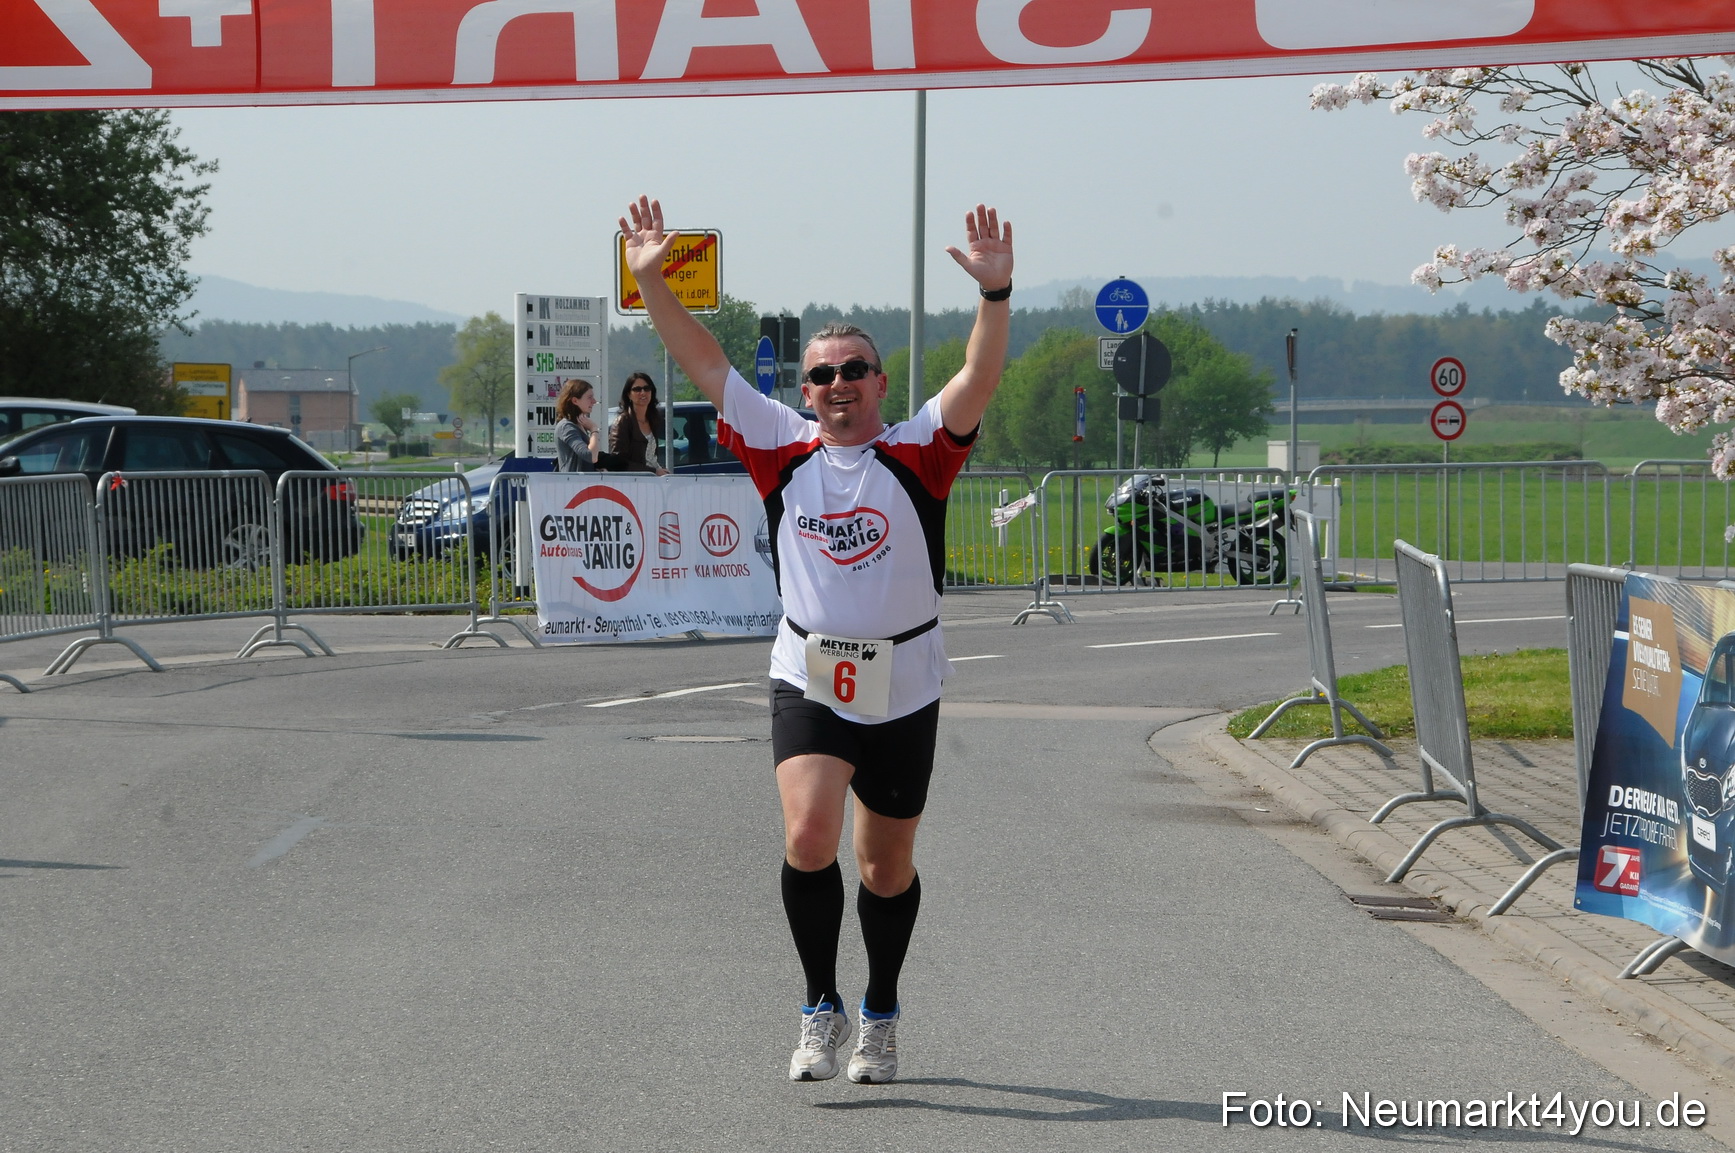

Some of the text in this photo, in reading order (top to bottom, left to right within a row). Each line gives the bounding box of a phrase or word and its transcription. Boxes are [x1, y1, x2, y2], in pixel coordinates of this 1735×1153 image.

[664, 244, 709, 262] enthal
[664, 269, 698, 282] Anger
[555, 298, 590, 311] HOLZAMMER
[555, 325, 590, 337] HOLZAMMER
[536, 352, 590, 373] SHB Holzfachmarkt
[1439, 368, 1459, 386] 60
[536, 407, 556, 425] THU
[540, 514, 632, 541] GERHART &
[706, 525, 733, 547] KIA
[797, 515, 875, 539] GERHART &
[798, 529, 829, 544] Autohaus
[540, 543, 583, 558] Autohaus
[582, 543, 635, 570] JÄNIG
[852, 544, 892, 573] seit 1996
[651, 567, 689, 580] SEAT
[695, 563, 751, 578] KIA MOTORS
[545, 616, 586, 635] eumarkt
[820, 639, 859, 652] MEYER
[820, 648, 860, 659] WERBUNG
[833, 660, 857, 704] 6
[1608, 785, 1641, 811] DER
[1600, 811, 1643, 838] JETZ
[1599, 851, 1631, 887] 7
